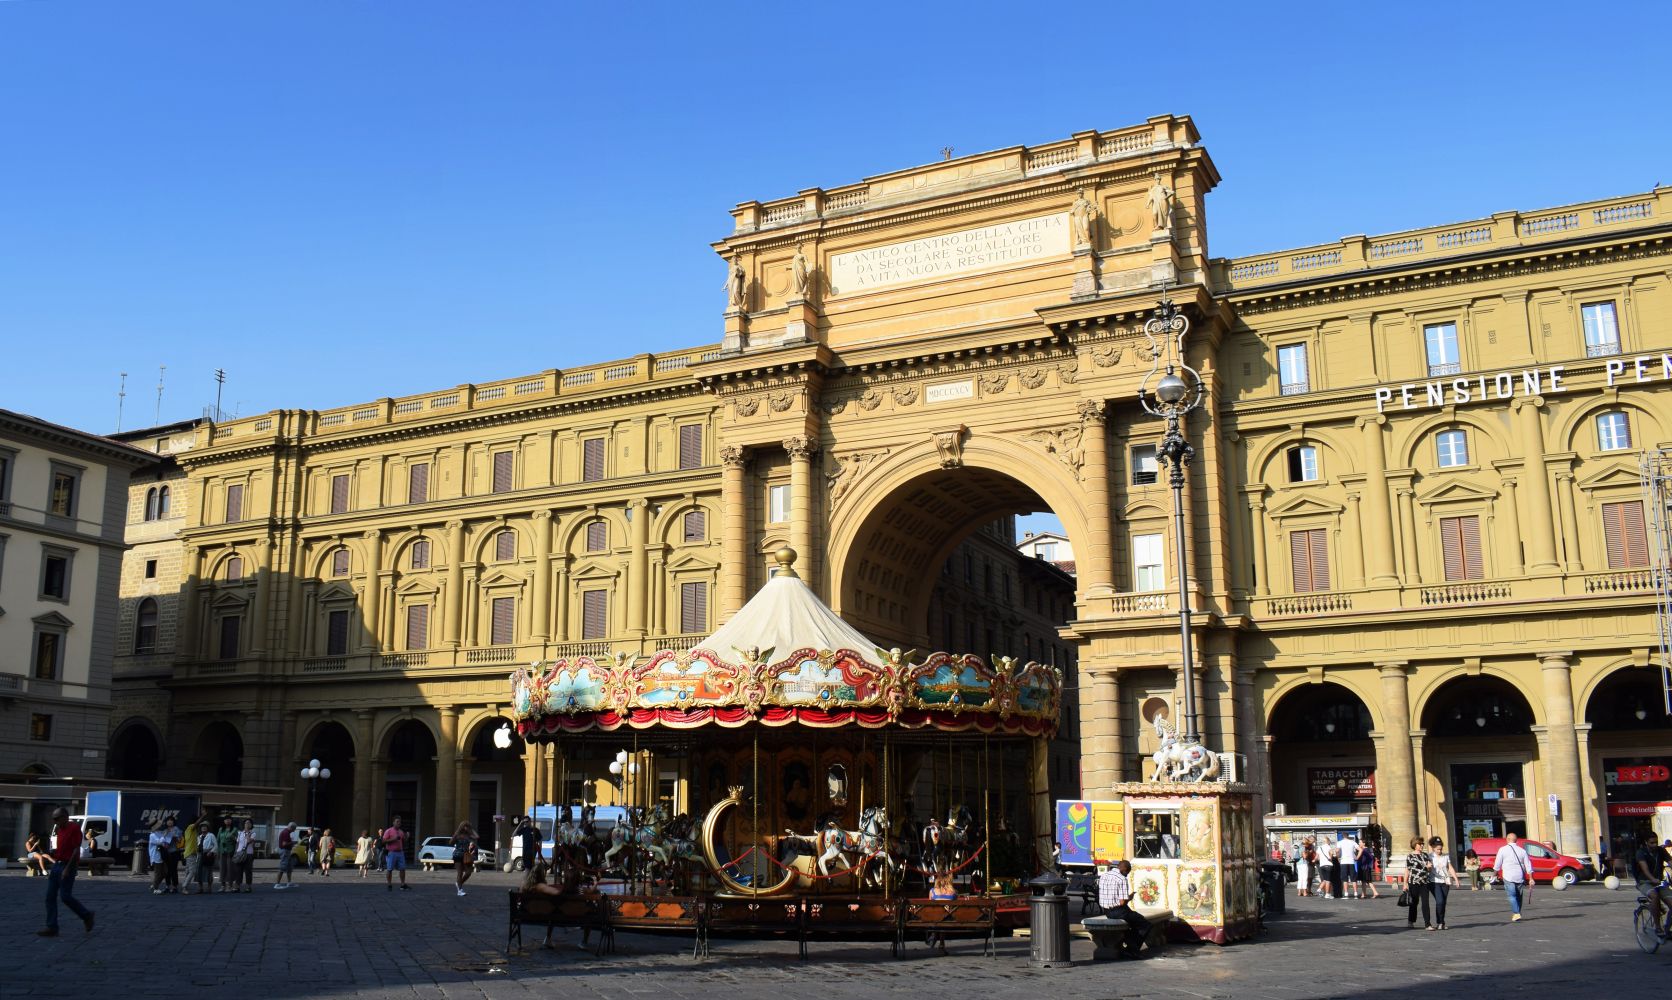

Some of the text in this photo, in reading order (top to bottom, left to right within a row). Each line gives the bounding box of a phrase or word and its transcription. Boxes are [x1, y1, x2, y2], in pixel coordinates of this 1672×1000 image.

[857, 232, 1041, 275] DA SECOLARE SQUALLORE
[904, 236, 960, 253] CENTRO
[965, 226, 1012, 243] DELLA
[857, 244, 1042, 286] A VITA NUOVA RESTITUITO
[1375, 366, 1568, 413] PENSIONE
[1316, 769, 1368, 778] TABACCHI
